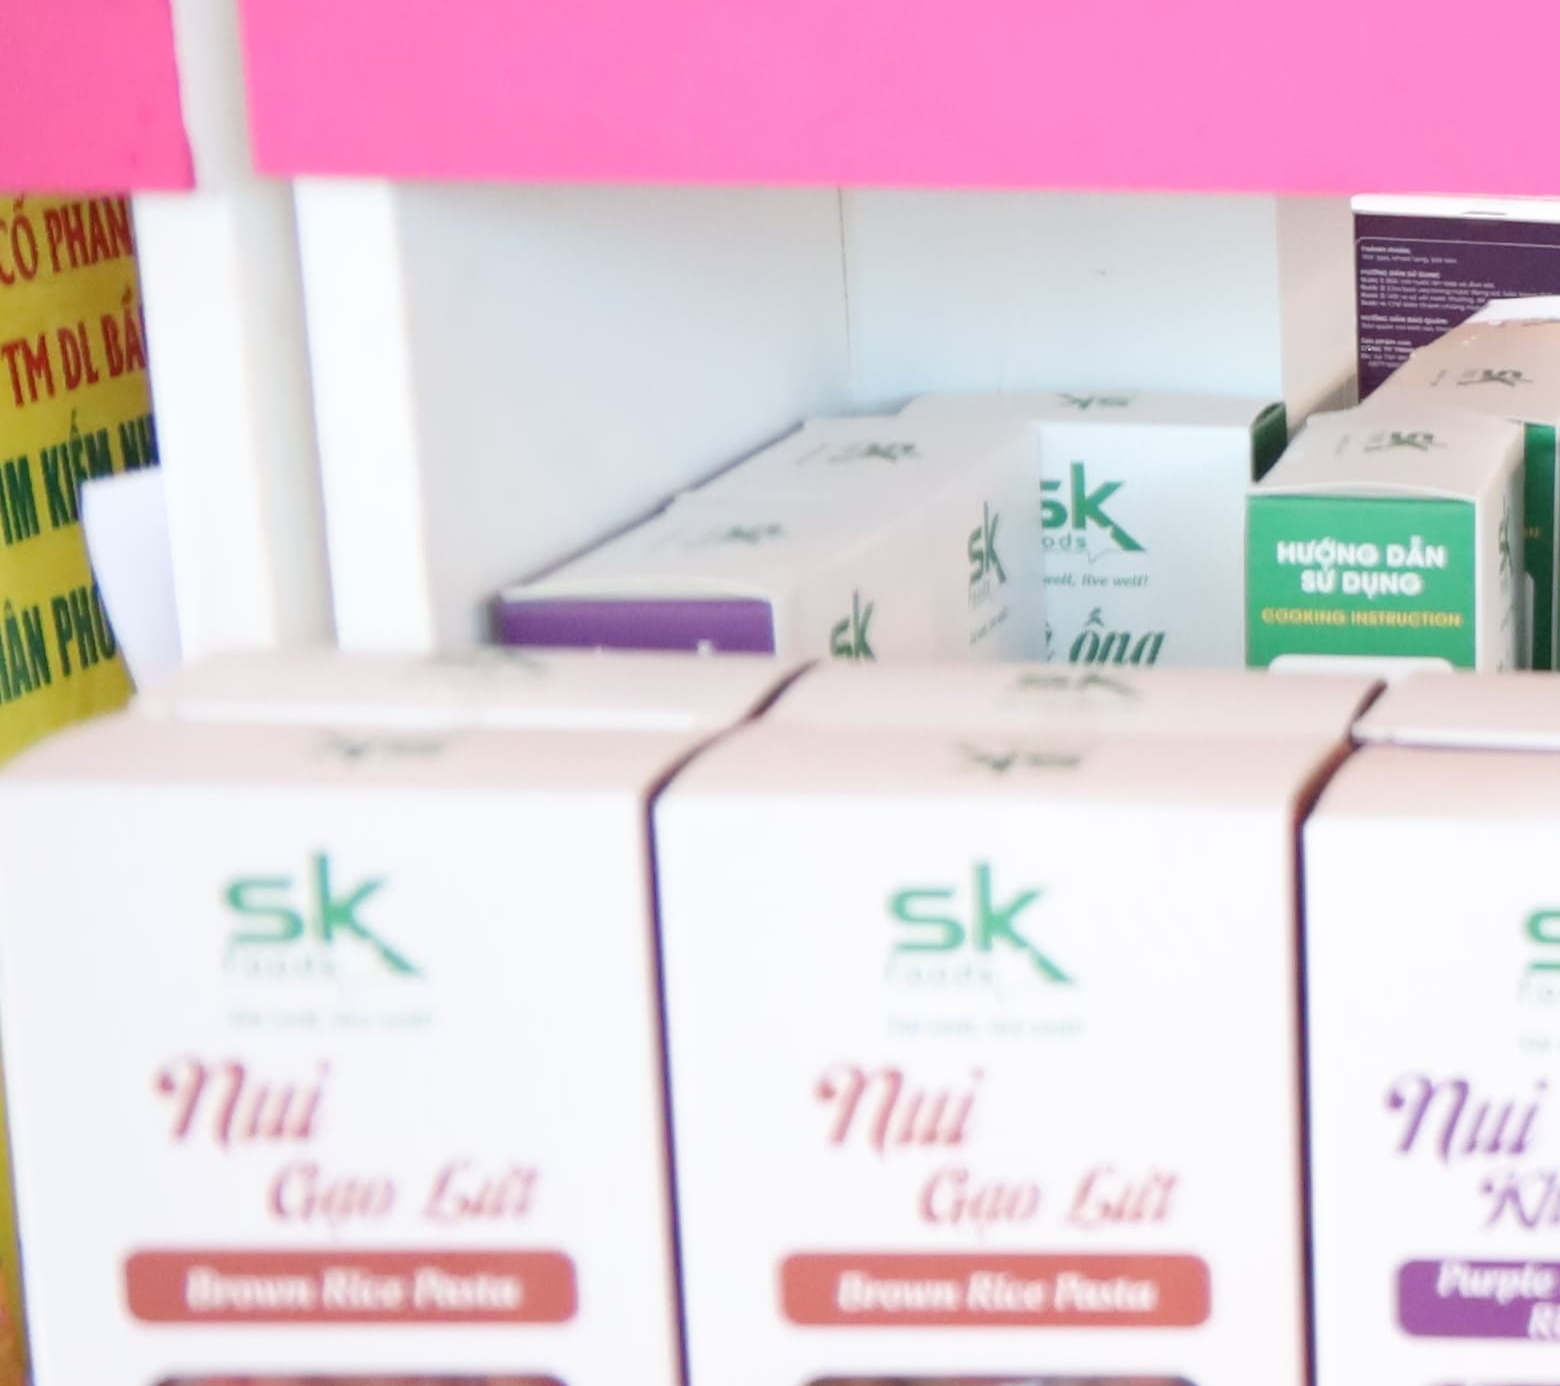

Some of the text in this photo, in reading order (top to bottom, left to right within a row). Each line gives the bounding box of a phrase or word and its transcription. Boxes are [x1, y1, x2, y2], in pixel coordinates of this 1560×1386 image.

[0, 333, 55, 407] TM
[1261, 606, 1348, 626] COOKING
[184, 1265, 521, 1313] Brown Rice Pasta
[836, 1269, 1158, 1316] Brown Rice Pasta
[1436, 1263, 1555, 1307] Purple
